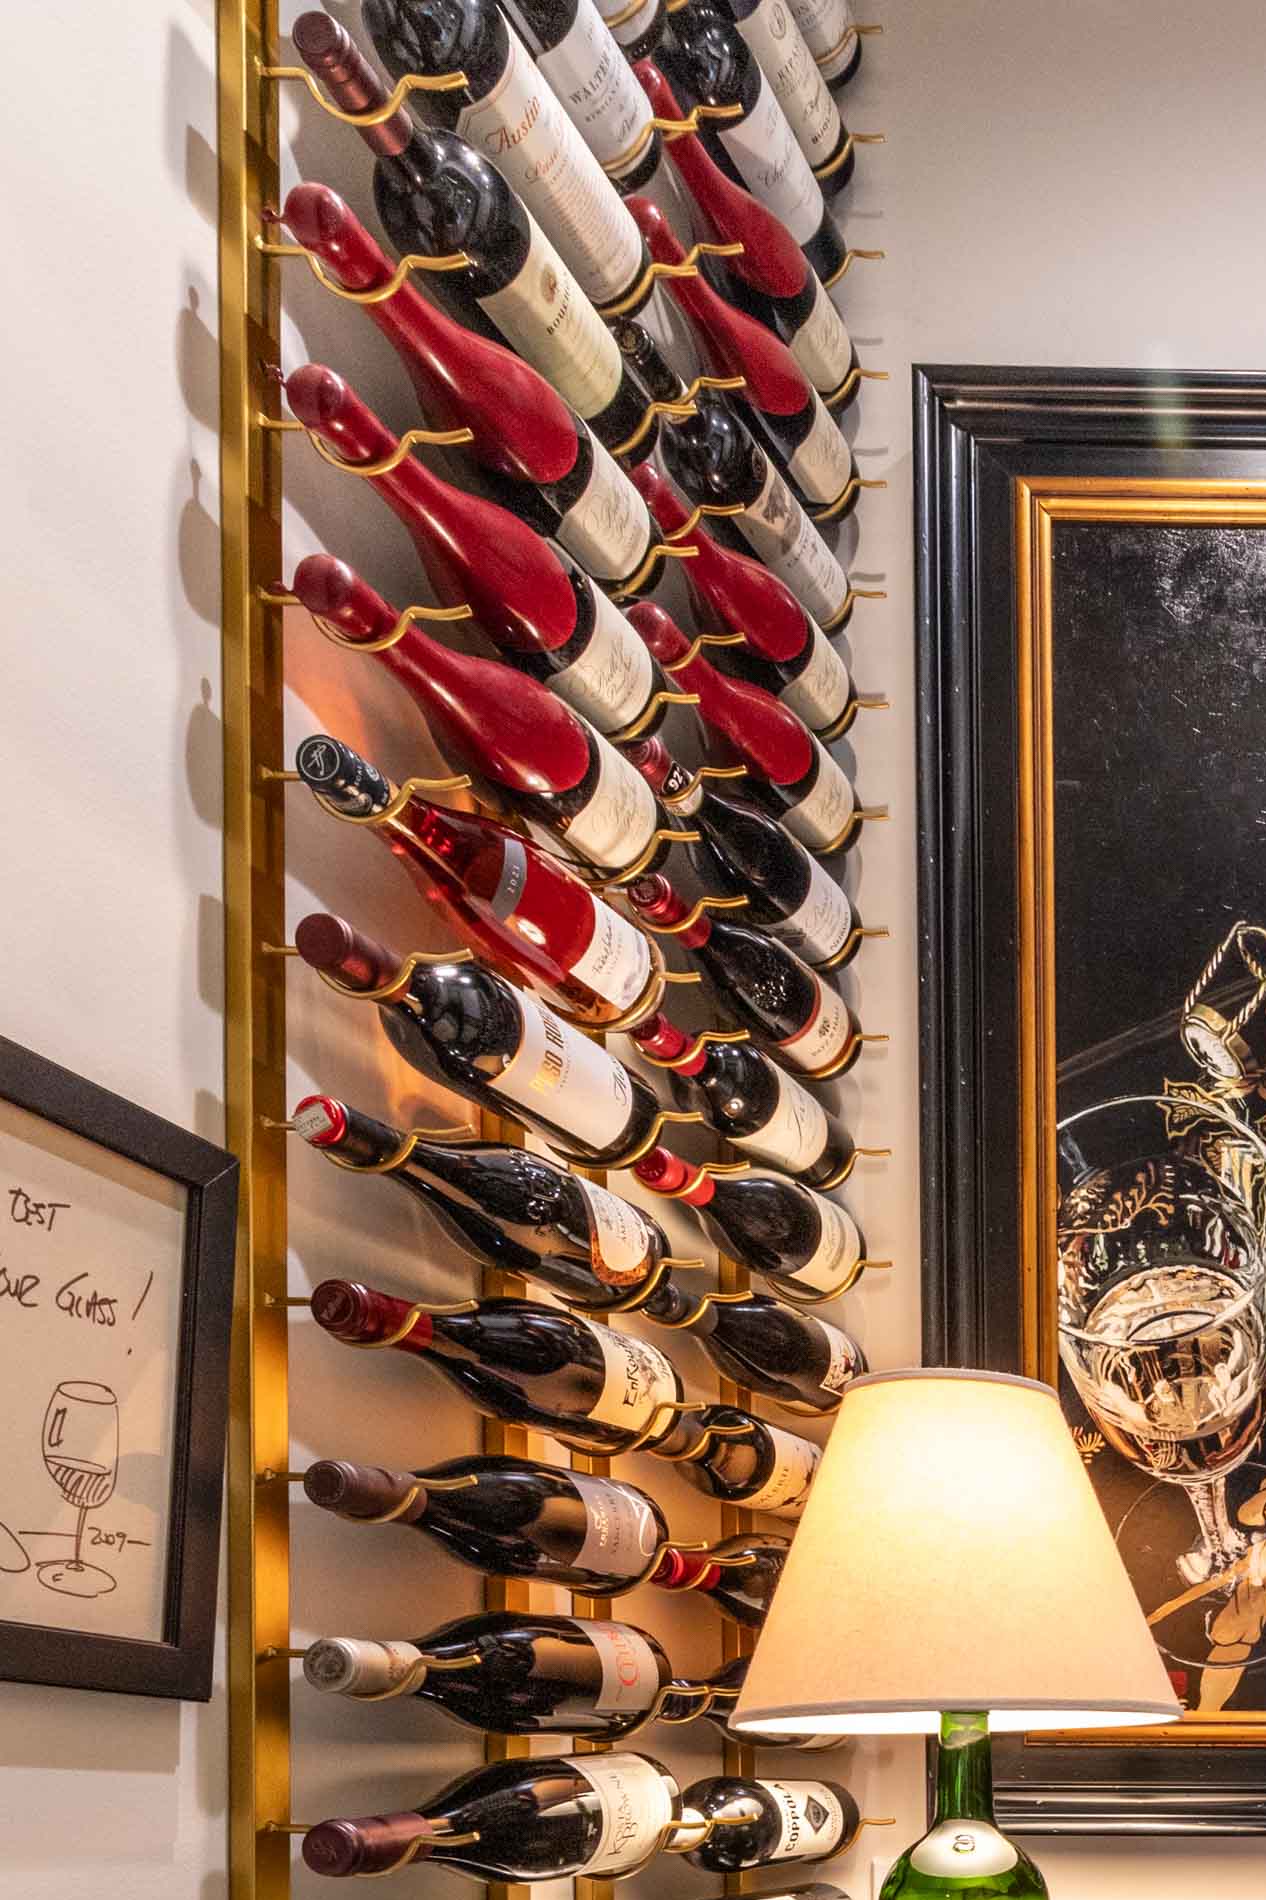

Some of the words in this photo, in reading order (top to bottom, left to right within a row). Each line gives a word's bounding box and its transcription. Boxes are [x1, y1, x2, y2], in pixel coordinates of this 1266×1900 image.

[668, 770, 684, 791] 92
[506, 864, 520, 895] 2021
[774, 1783, 801, 1853] COPPOLA
